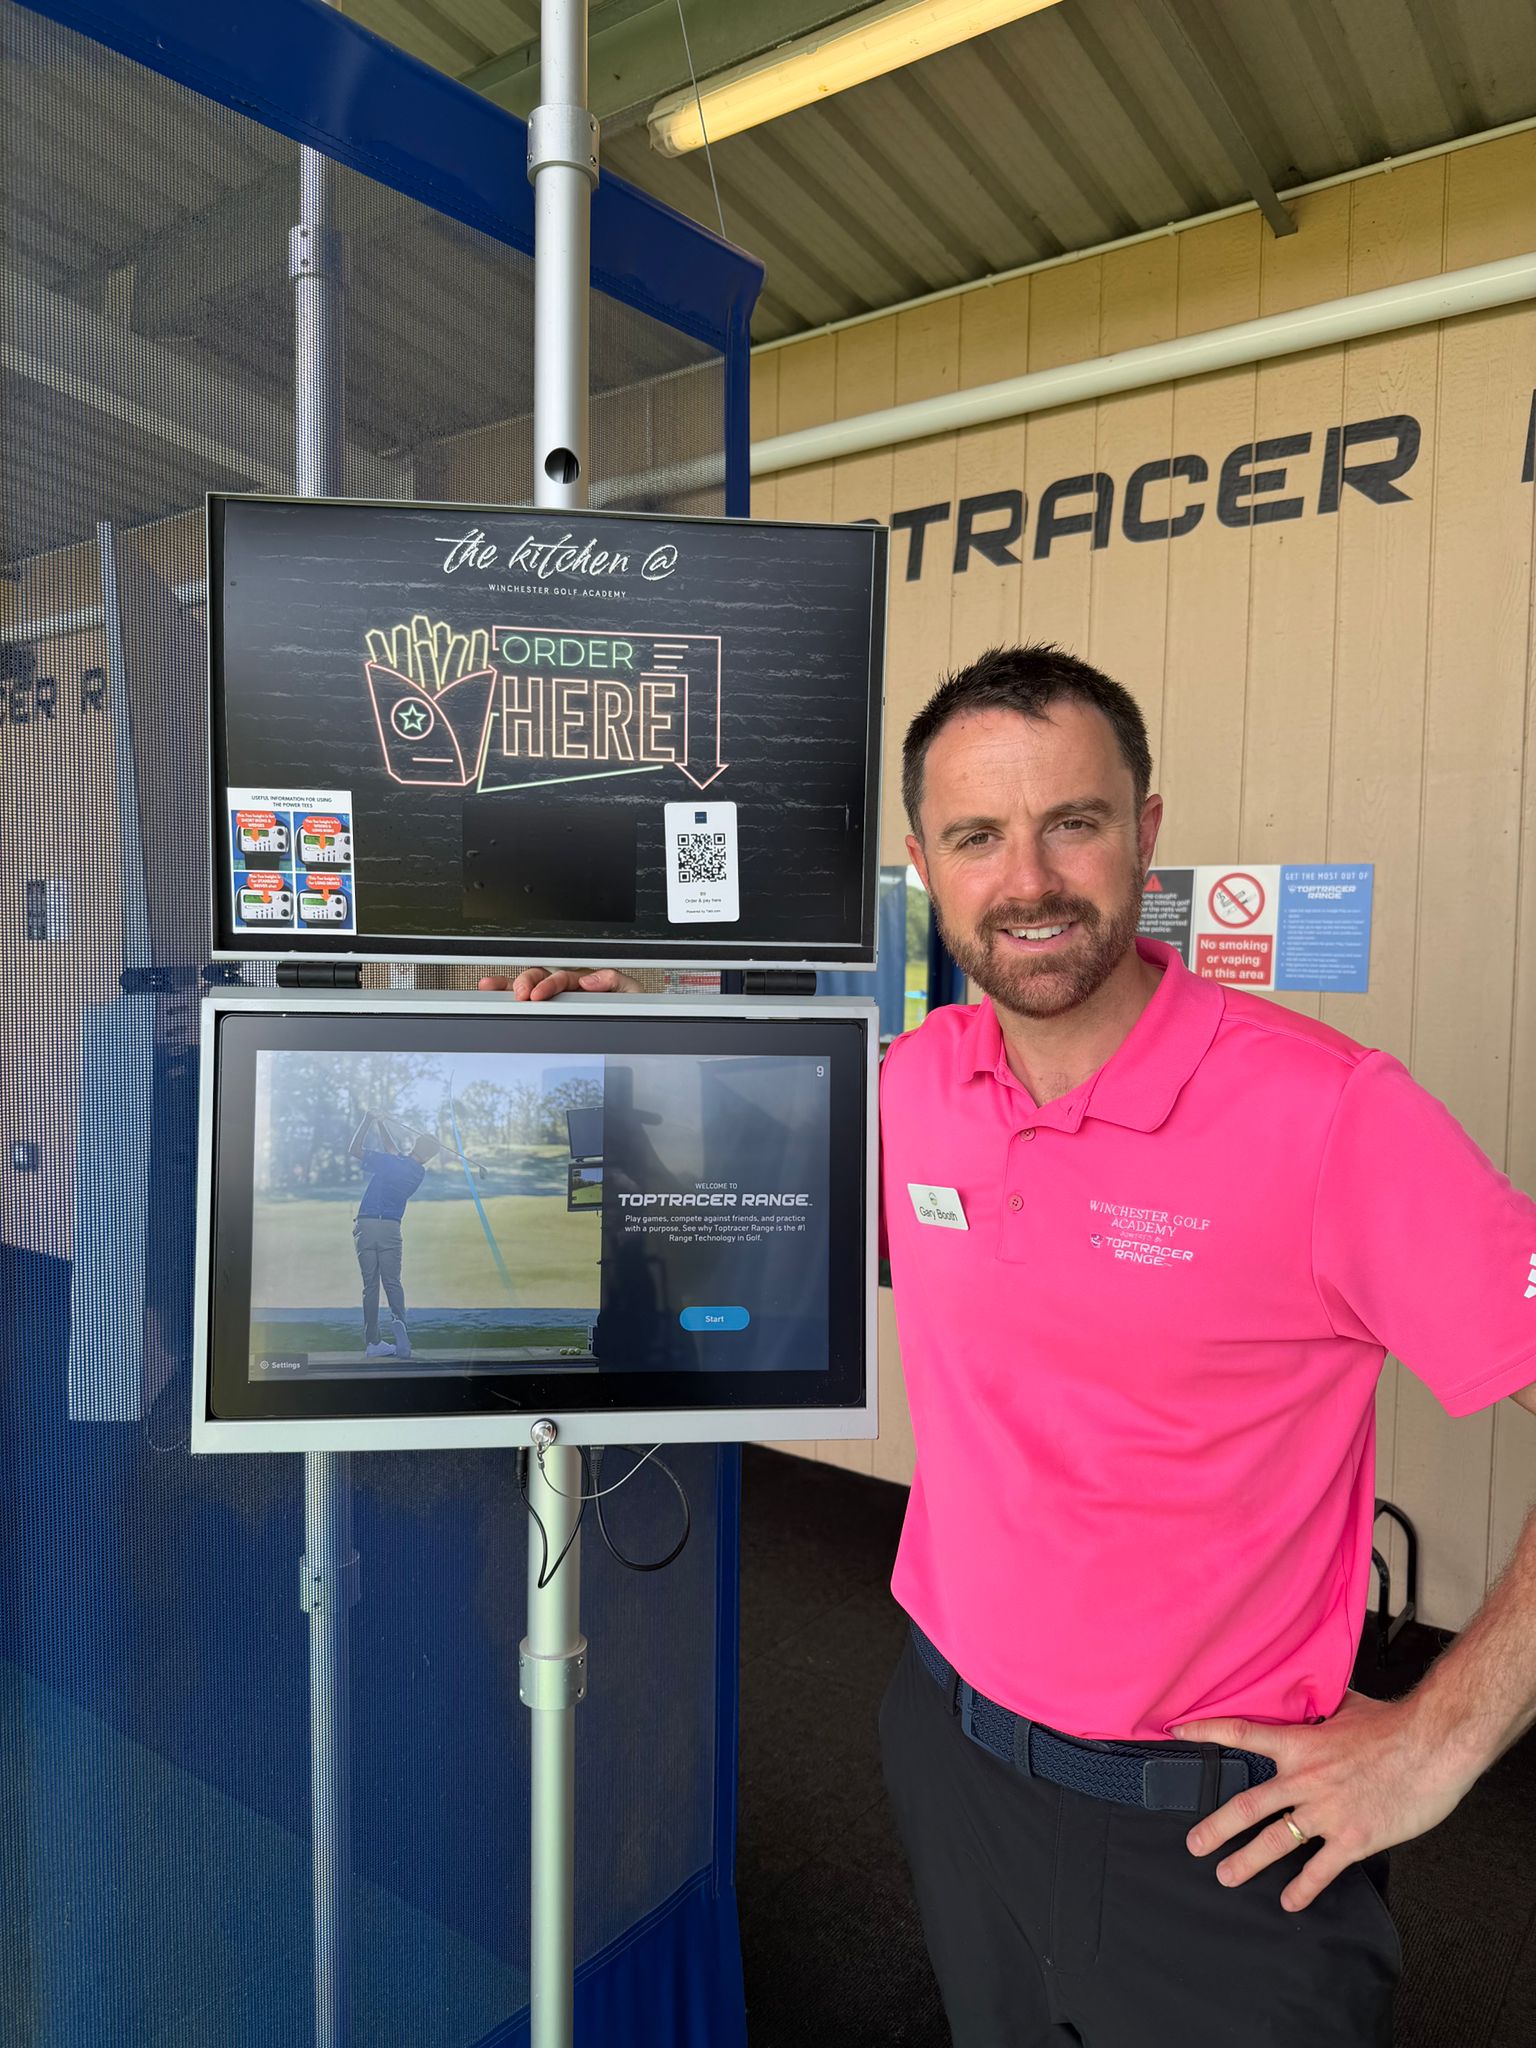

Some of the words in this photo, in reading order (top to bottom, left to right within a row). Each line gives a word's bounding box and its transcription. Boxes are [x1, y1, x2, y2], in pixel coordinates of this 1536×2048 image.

[846, 414, 1421, 582] TRACER
[434, 528, 499, 574] the
[508, 533, 630, 580] kitchen
[641, 544, 679, 581] @
[488, 583, 550, 595] WINCHESTER
[553, 586, 578, 597] GOLF
[582, 588, 627, 599] ACADEMY
[502, 635, 634, 670] ORDER
[502, 675, 677, 763] HERE
[1285, 872, 1298, 880] GET
[1302, 872, 1315, 880] THE
[1318, 872, 1338, 880] MOST
[1341, 872, 1356, 880] OUT
[1358, 871, 1369, 880] OF
[1296, 885, 1356, 893] TOPTRACER
[1200, 940, 1216, 950] No
[1218, 940, 1268, 953] smoking
[1206, 955, 1219, 964] or
[1221, 955, 1260, 967] vaping
[1201, 968, 1212, 978] in
[1215, 969, 1235, 979] this
[1239, 971, 1264, 979] area
[816, 1065, 824, 1077] 9
[617, 1193, 738, 1207] TOPTRACER
[625, 1215, 641, 1223] Play
[703, 1215, 731, 1223] against
[732, 1215, 759, 1223] friends,
[776, 1215, 806, 1223] practice
[919, 1206, 936, 1220] Gary
[936, 1208, 958, 1221] Booth
[1089, 1200, 1169, 1223] WINCHESTER
[1173, 1215, 1211, 1231] GOLF
[697, 1225, 713, 1233] why
[714, 1225, 750, 1233] Toptracer
[751, 1225, 775, 1233] Range
[1111, 1218, 1177, 1237] ACADEMY
[669, 1235, 693, 1243] Range
[694, 1235, 736, 1243] Technology
[745, 1234, 763, 1242] Golf.
[1105, 1236, 1194, 1261] TOPTRACER
[1114, 1249, 1166, 1266] RANGE
[705, 1315, 724, 1323] Start
[271, 1361, 301, 1370] Settings
